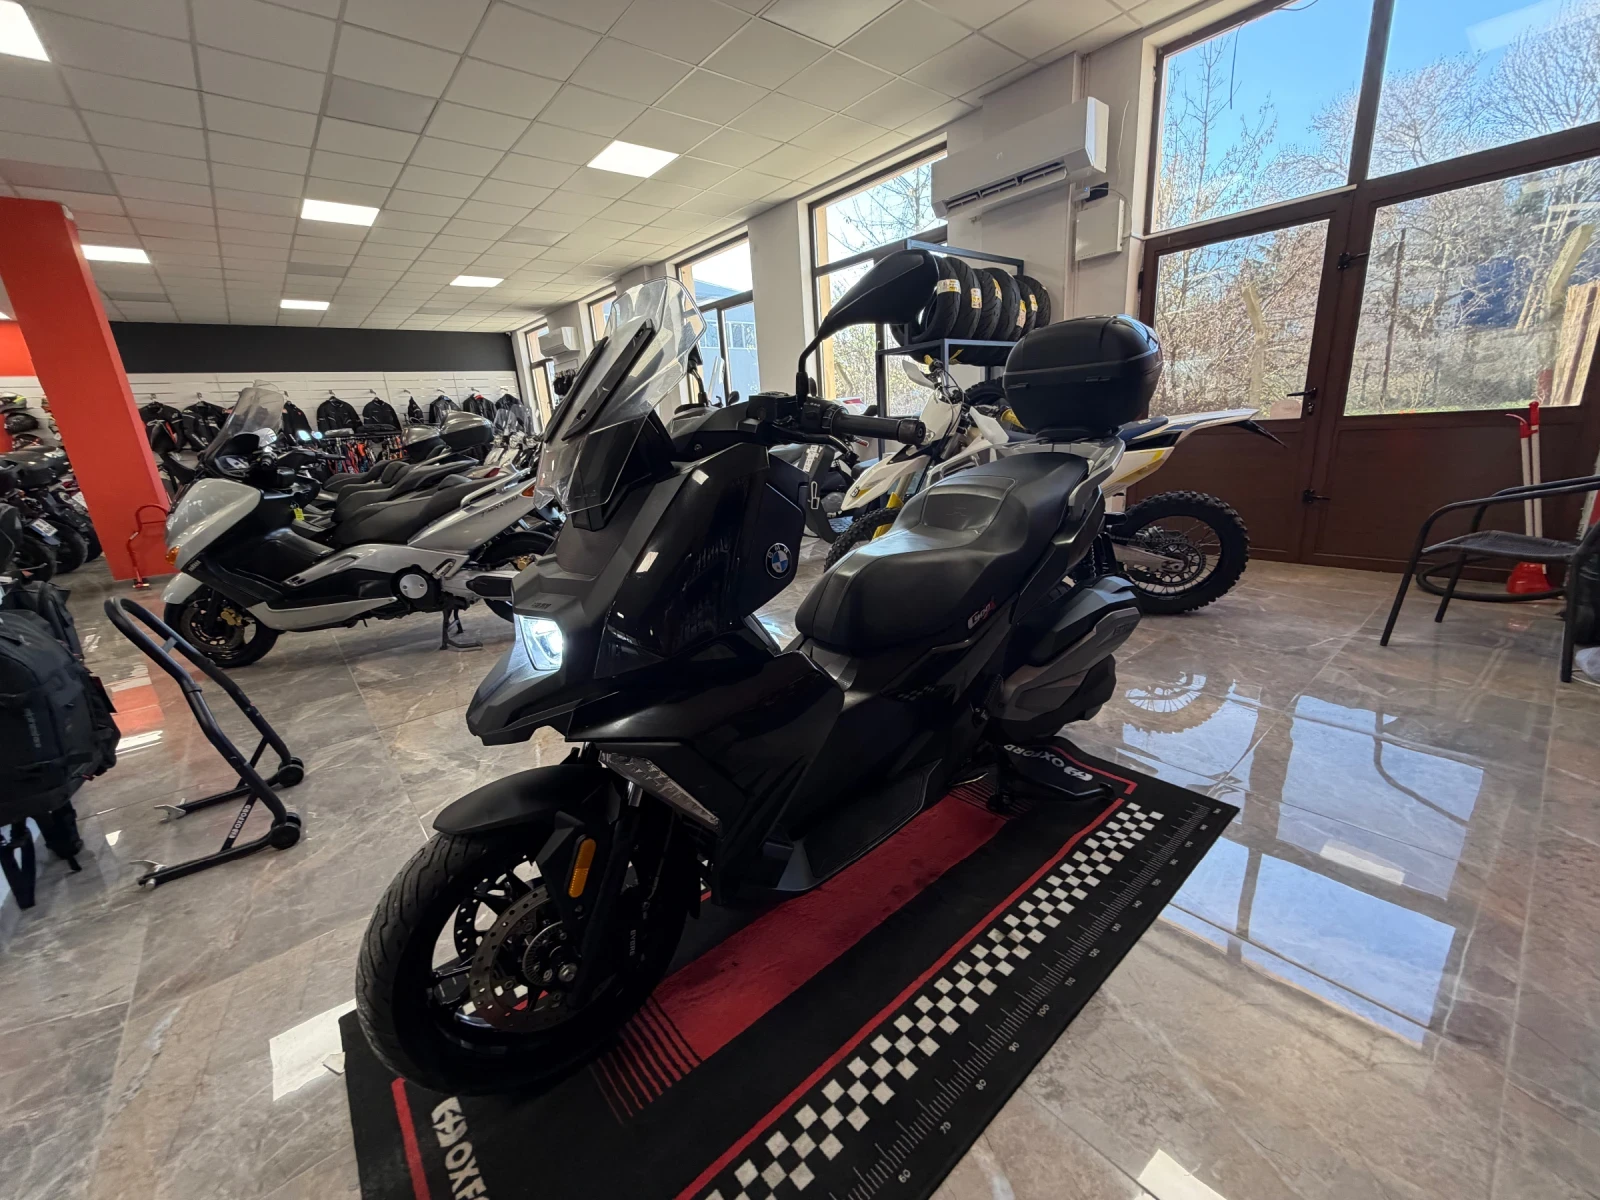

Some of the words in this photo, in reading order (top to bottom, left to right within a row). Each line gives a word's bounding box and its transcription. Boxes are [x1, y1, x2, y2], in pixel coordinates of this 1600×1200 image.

[1004, 744, 1065, 768] OXFORD
[234, 804, 252, 829] OXFORD
[1132, 900, 1143, 908] 140
[629, 929, 637, 957] BYBRE
[1088, 948, 1101, 958] 120
[1064, 976, 1076, 987] 110
[1036, 1003, 1050, 1018] 100
[1008, 1041, 1020, 1052] 90
[975, 1078, 987, 1091] 80
[939, 1121, 952, 1135] 70
[445, 1141, 490, 1200] OXF
[897, 1169, 911, 1183] 60
